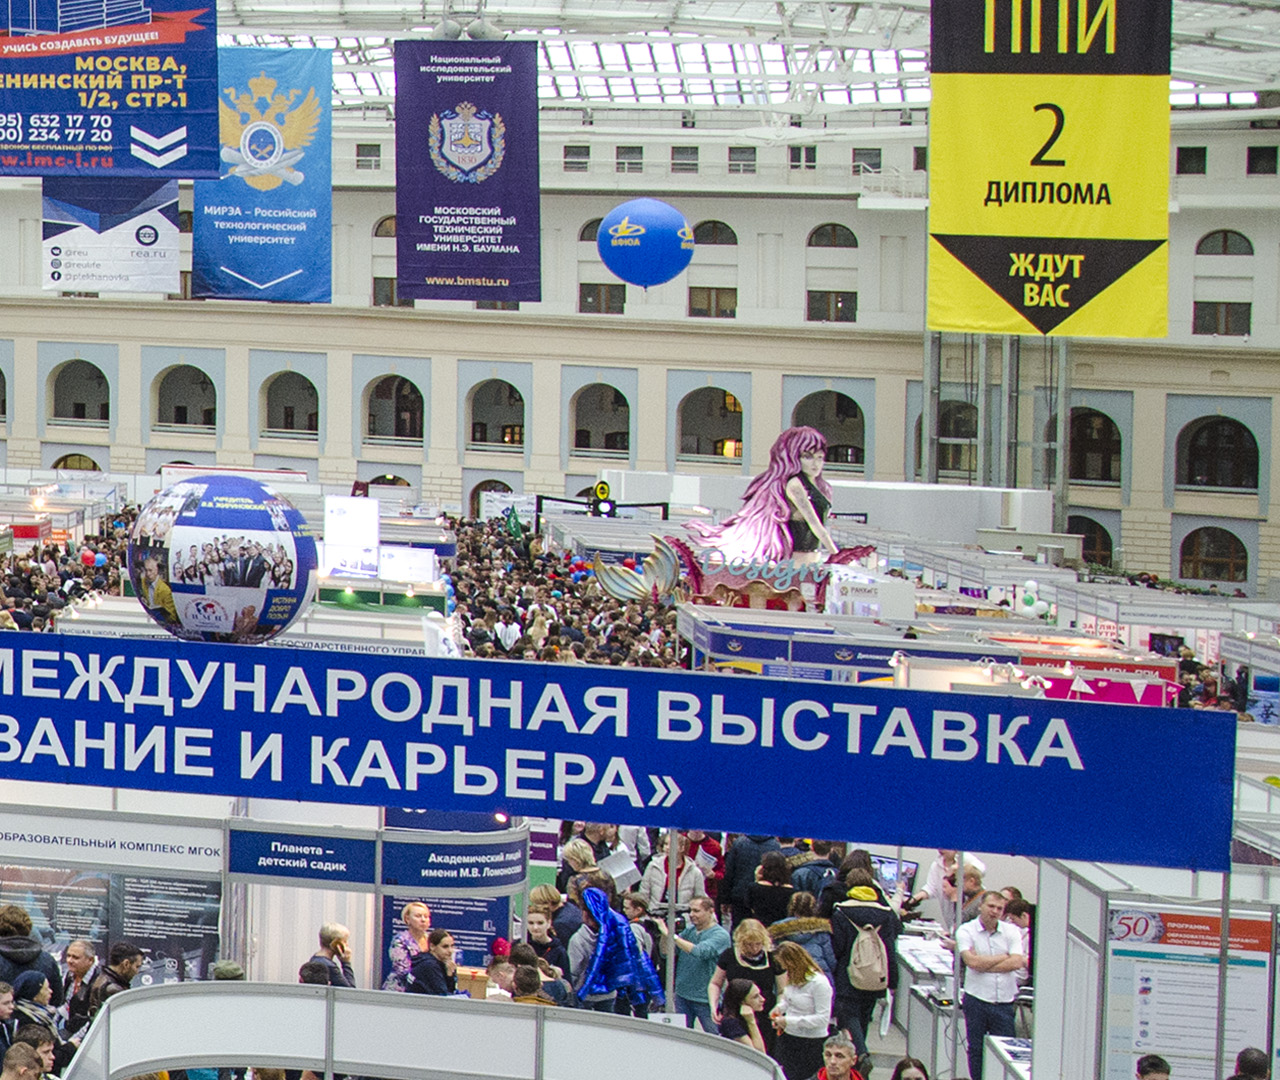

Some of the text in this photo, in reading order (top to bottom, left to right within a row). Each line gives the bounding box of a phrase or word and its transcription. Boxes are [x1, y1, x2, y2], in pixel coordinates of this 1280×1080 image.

[3, 31, 159, 54] УЧИСЬ СОЗДАВАТЬ БУДУЩЕЕ!
[75, 57, 187, 75] МОСКВА,
[430, 55, 501, 65] Национальный
[420, 64, 512, 74] исследовательский
[131, 75, 186, 89] ПР-Т
[437, 75, 495, 83] университет
[79, 92, 187, 109] 1/2, СТР.1
[30, 114, 60, 126] 632
[66, 115, 83, 126] 17
[90, 114, 112, 126] 70
[28, 129, 60, 140] 234
[65, 129, 85, 140] 77
[90, 129, 112, 140] 20
[1030, 102, 1066, 167] 2
[984, 180, 1112, 207] ДИПЛОМА
[204, 207, 317, 220] МИРЭА Российский
[434, 206, 501, 216] МОСКОВСКИЙ
[214, 220, 307, 233] технологический
[419, 215, 516, 225] ГОСУДАРСТВЕННЫЙ
[432, 224, 503, 235] ТЕХНИЧЕСКИЙ
[228, 234, 296, 247] университет
[433, 235, 502, 244] УНИВЕРСИТЕТ
[130, 249, 166, 258] rea.ru
[416, 243, 450, 253] ИМЕНИ
[476, 244, 520, 254] БАУМАНА
[1009, 253, 1085, 282] ЖДУТ
[425, 275, 509, 287] www.bmstu.ru
[1024, 283, 1070, 308] ВАС
[699, 546, 832, 590] Design
[658, 691, 1085, 771] ВЫСТАВКА
[240, 734, 283, 781] И
[310, 738, 683, 808] КАРЬЕРА»
[120, 840, 184, 855] КОМПЛЕКС
[188, 846, 221, 857] МГОК
[271, 841, 323, 856] Планета
[257, 855, 346, 872] детский садик
[428, 851, 503, 864] Академический
[421, 867, 456, 879] имени
[458, 866, 481, 878] М.В.
[1116, 916, 1150, 940] 50
